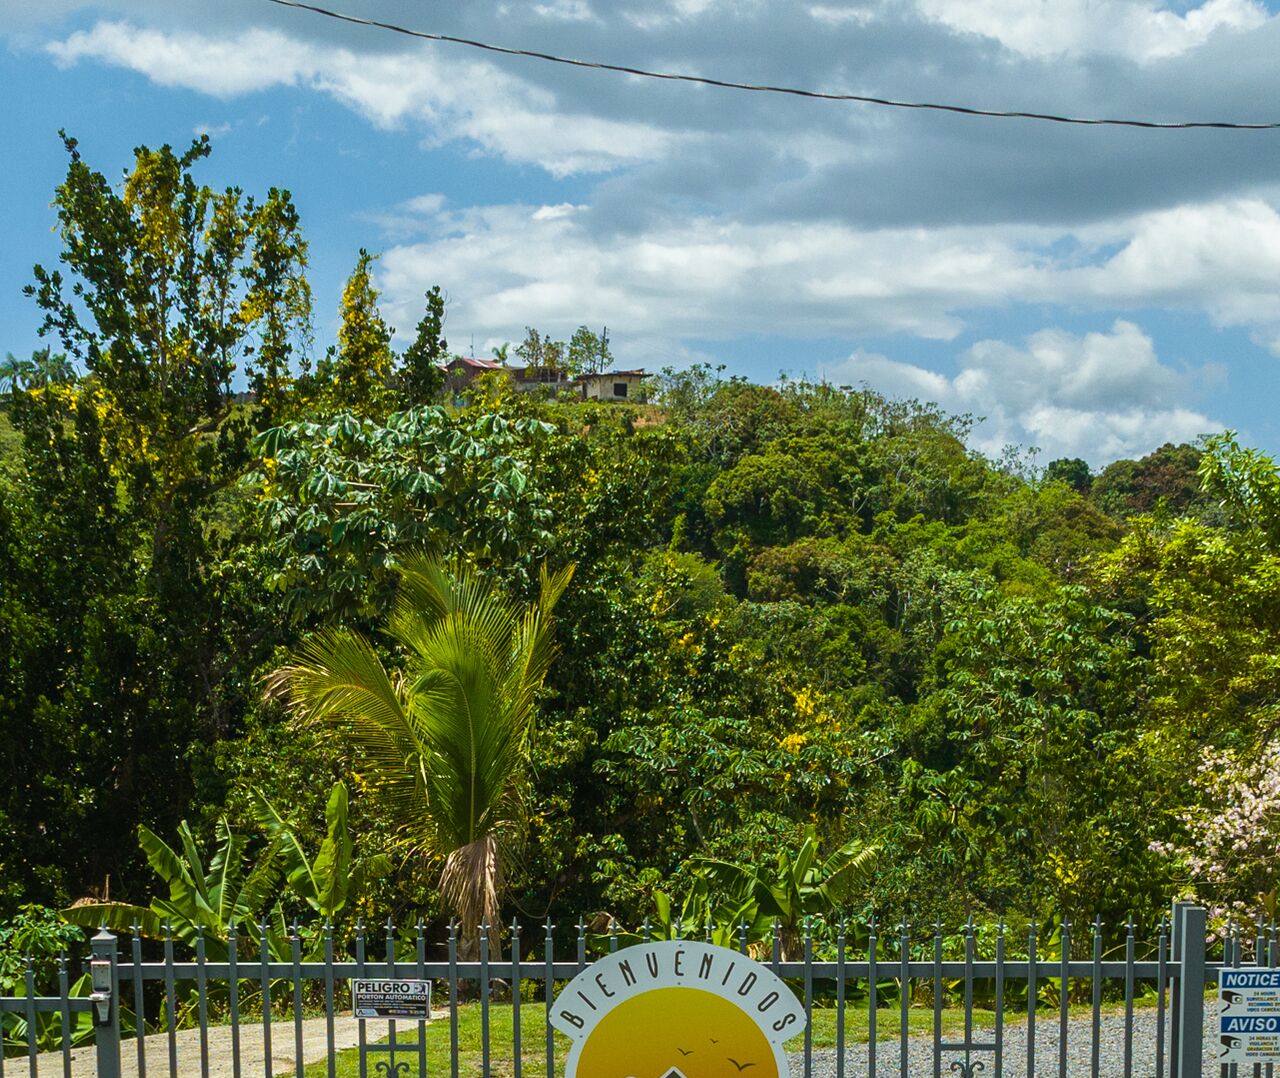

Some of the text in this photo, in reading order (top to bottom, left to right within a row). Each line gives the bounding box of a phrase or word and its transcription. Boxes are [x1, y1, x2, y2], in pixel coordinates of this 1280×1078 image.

[1226, 974, 1280, 986] NOTICE
[357, 983, 410, 993] PELIGRO
[560, 951, 797, 1032] BIENVENIDOS
[1227, 1018, 1277, 1031] AVISO
